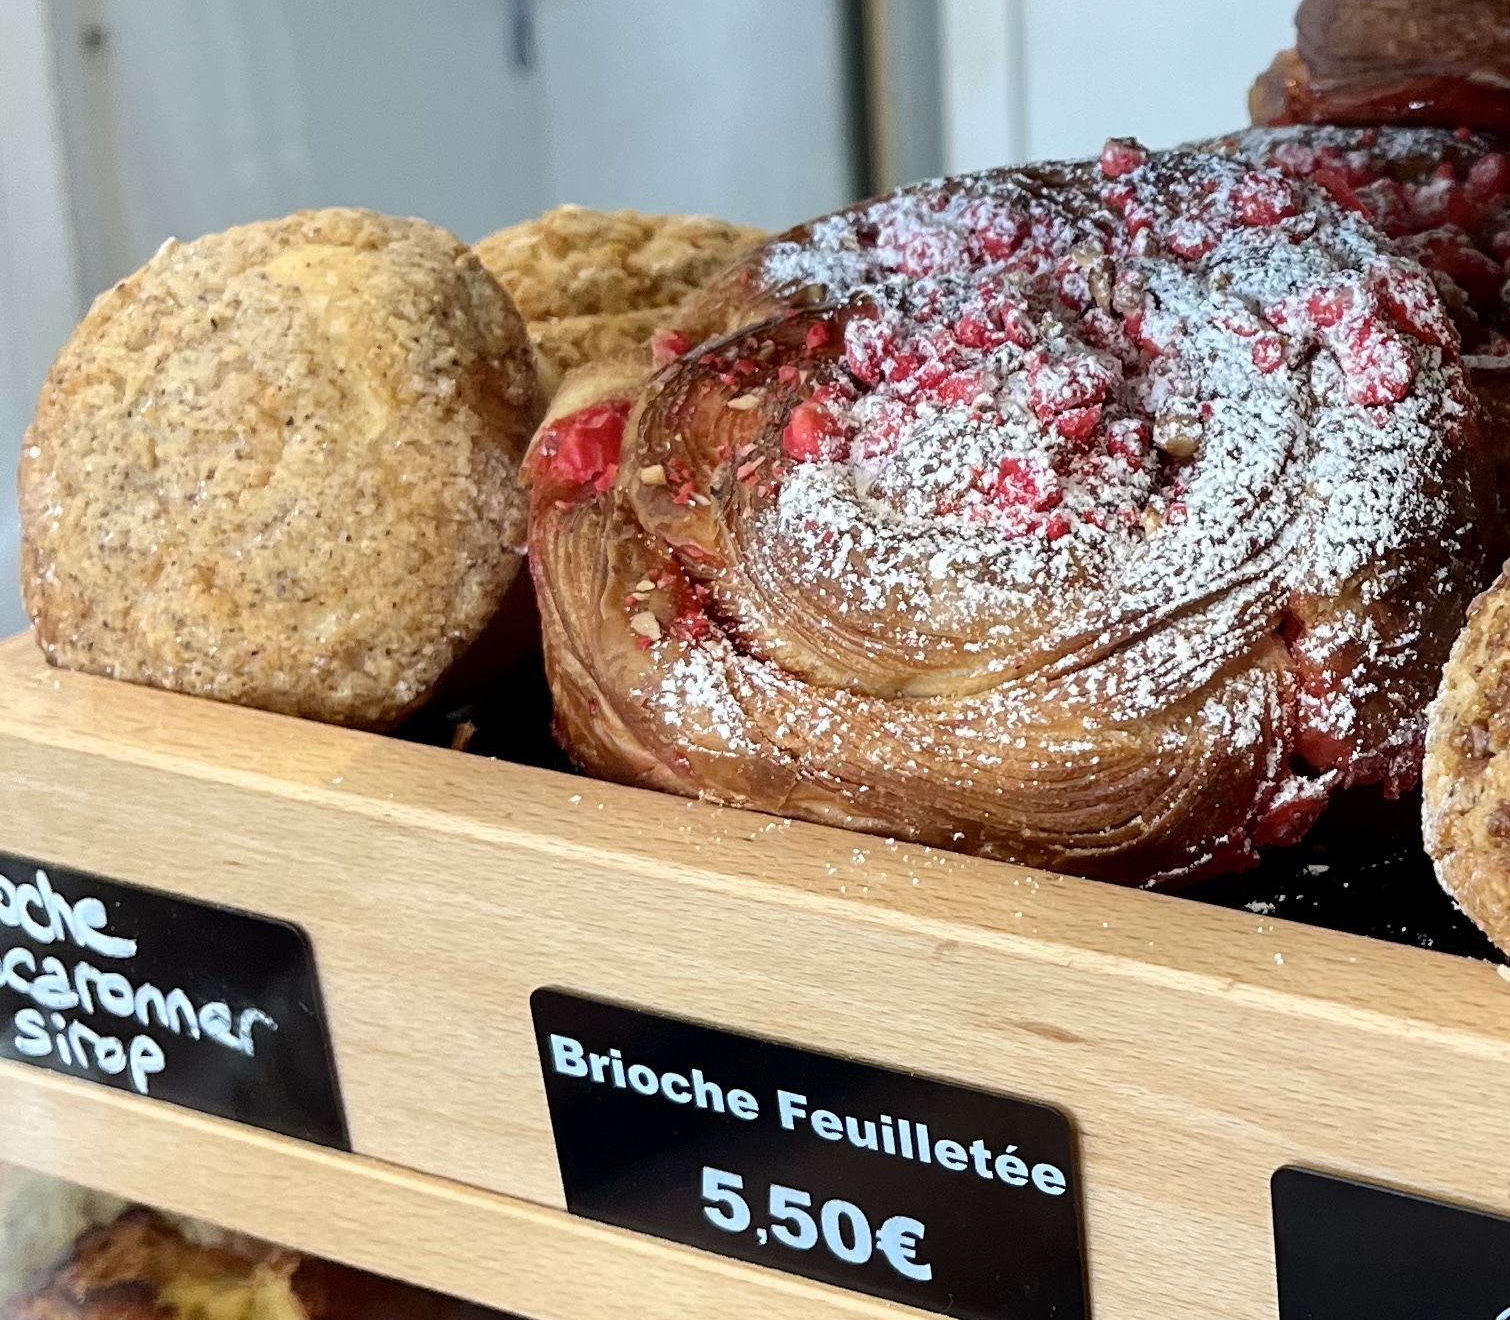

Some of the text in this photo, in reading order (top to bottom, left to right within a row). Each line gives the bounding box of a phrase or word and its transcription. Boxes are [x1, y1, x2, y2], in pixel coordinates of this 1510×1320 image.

[14, 1007, 166, 1095] sirop
[547, 1032, 1068, 1197] Brioche Feuilletée
[700, 1164, 934, 1283] 5,50€
